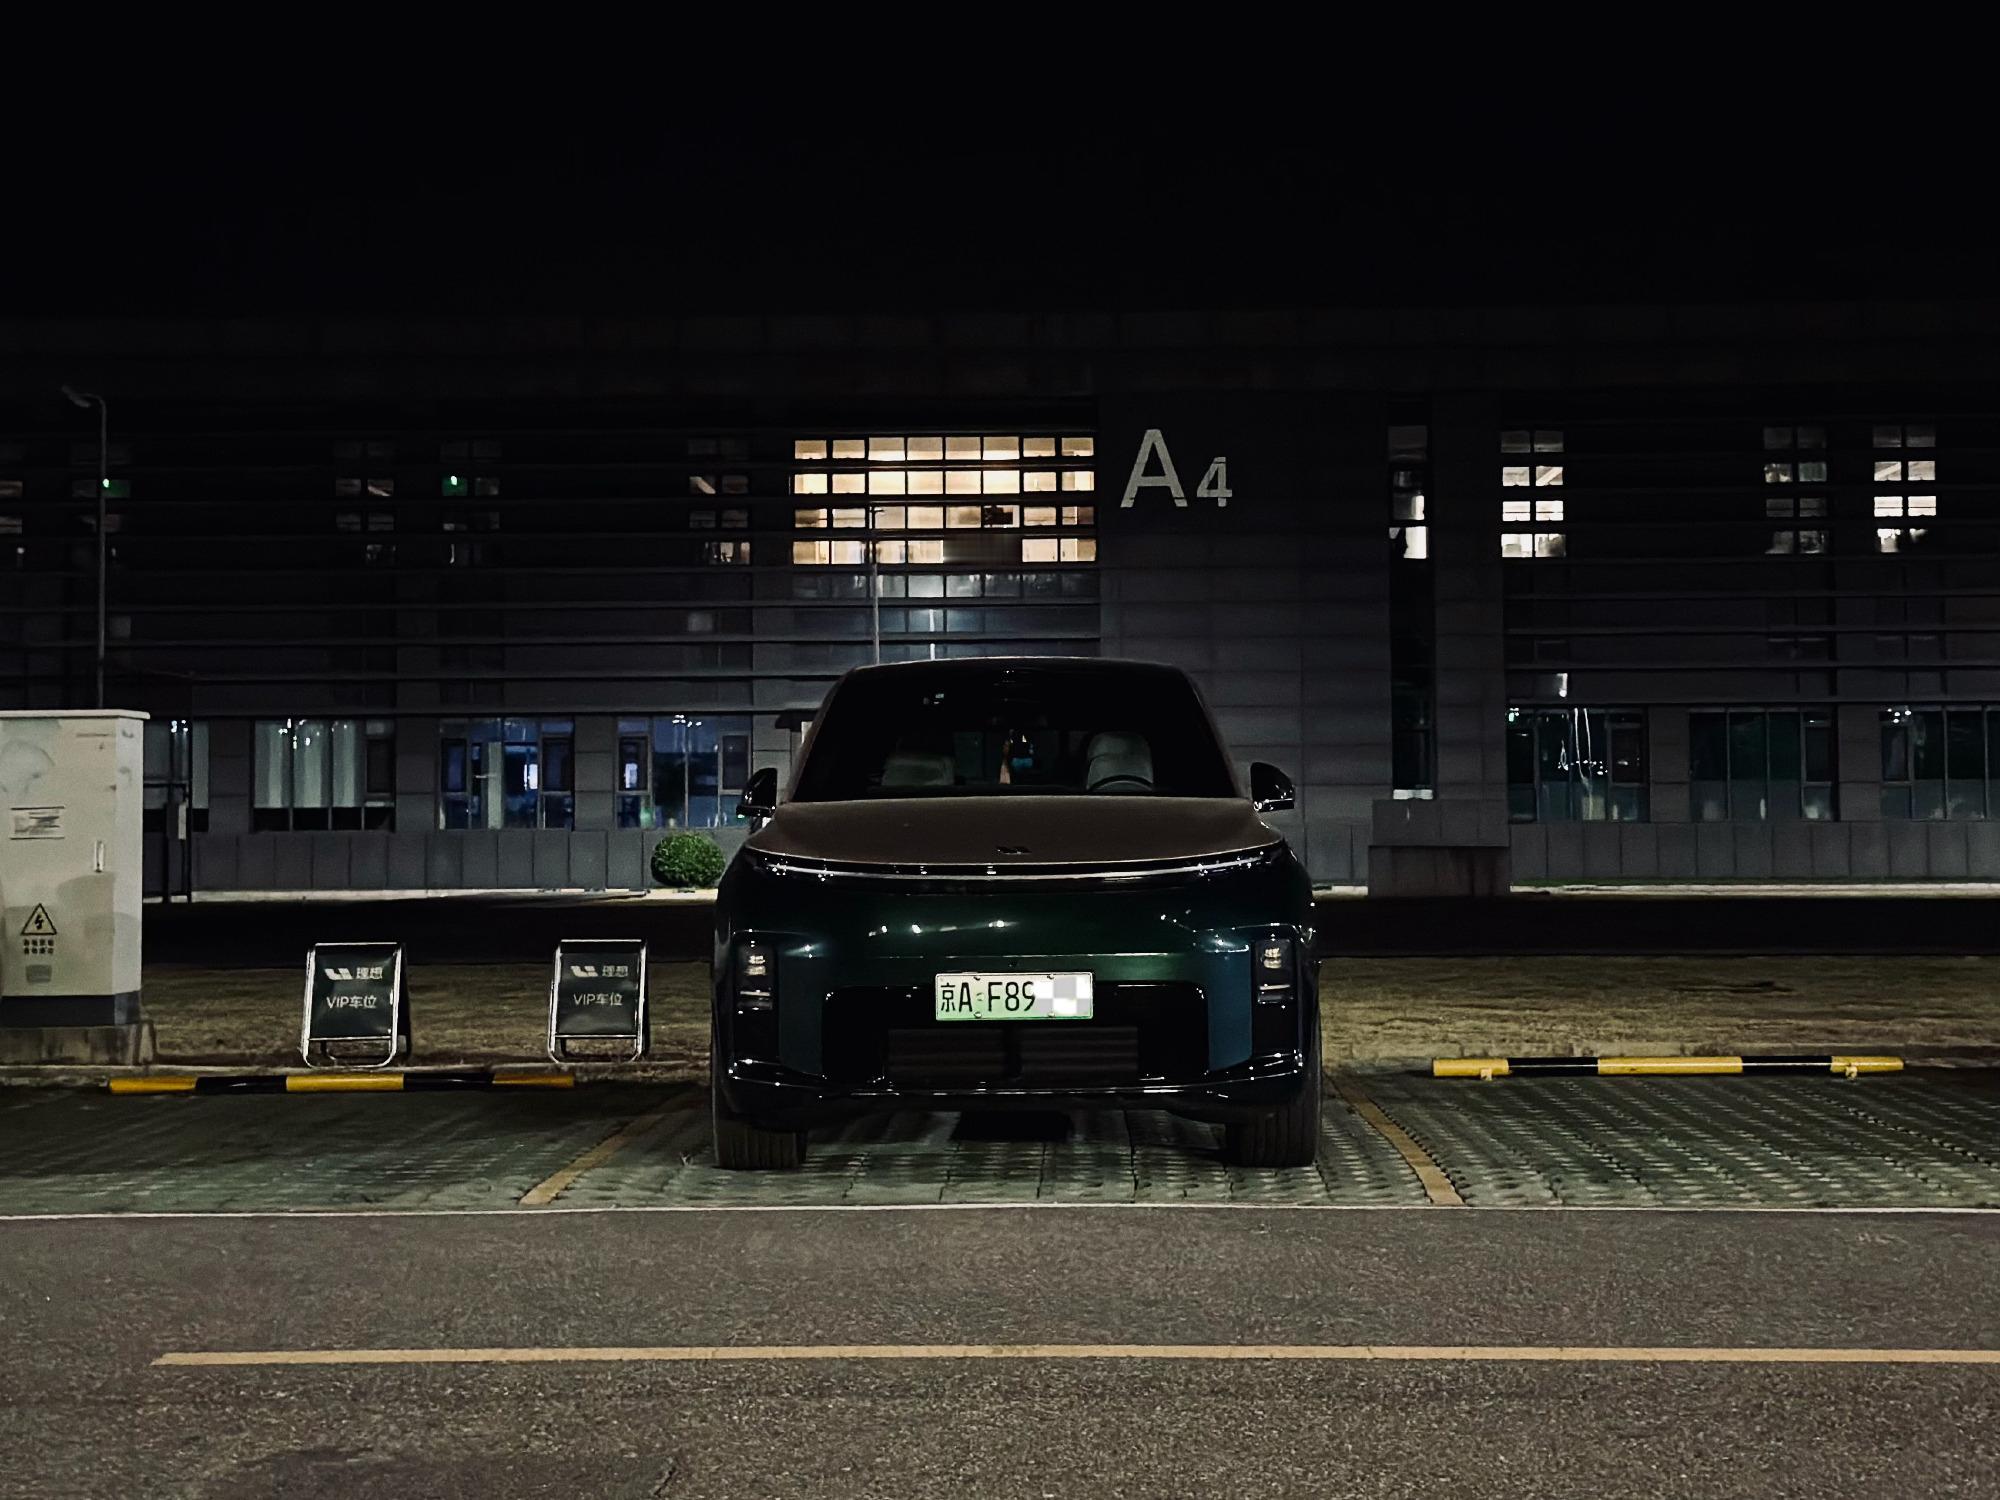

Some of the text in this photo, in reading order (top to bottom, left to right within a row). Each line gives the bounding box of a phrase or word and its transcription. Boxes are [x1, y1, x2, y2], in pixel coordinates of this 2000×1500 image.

[1120, 428, 1233, 508] A4
[326, 994, 377, 1009] VIP车位
[573, 992, 623, 1007] VIP车位
